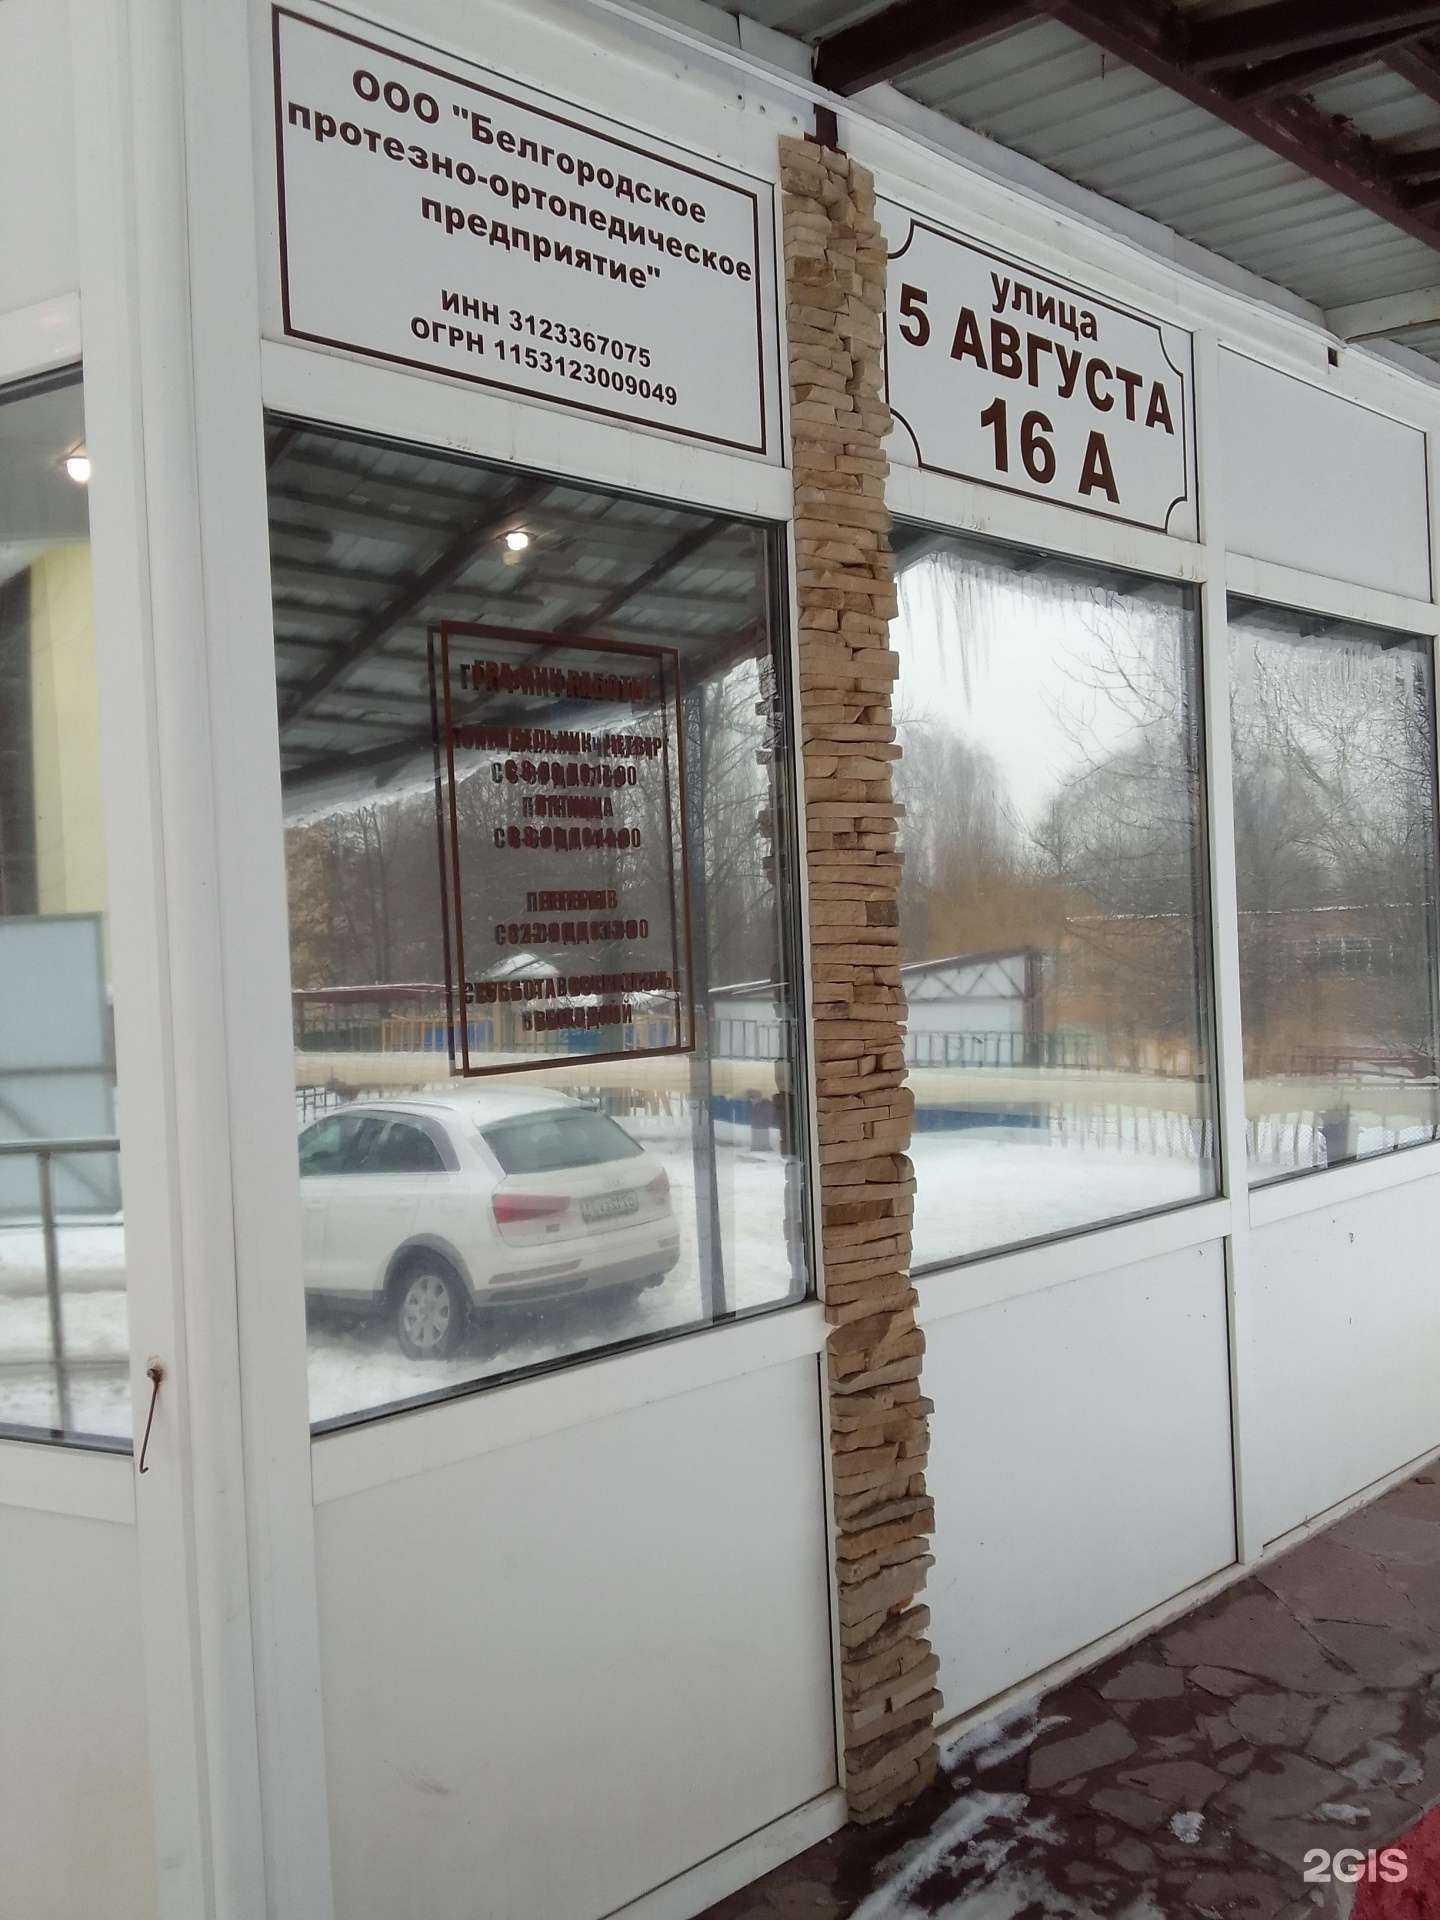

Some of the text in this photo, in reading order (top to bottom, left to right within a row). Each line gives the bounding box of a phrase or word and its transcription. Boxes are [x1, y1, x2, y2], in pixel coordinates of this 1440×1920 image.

[288, 100, 752, 282] протезно-ортопедическое
[352, 69, 707, 224] ООО "Белгородское
[421, 196, 661, 289] предприятие"
[441, 288, 651, 368] ИНН 3123367075
[989, 271, 1098, 342] улица
[410, 316, 678, 406] ОГРН 1153123009049
[898, 282, 1175, 436] 5 АВГУСТА
[980, 397, 1121, 505] 16 А
